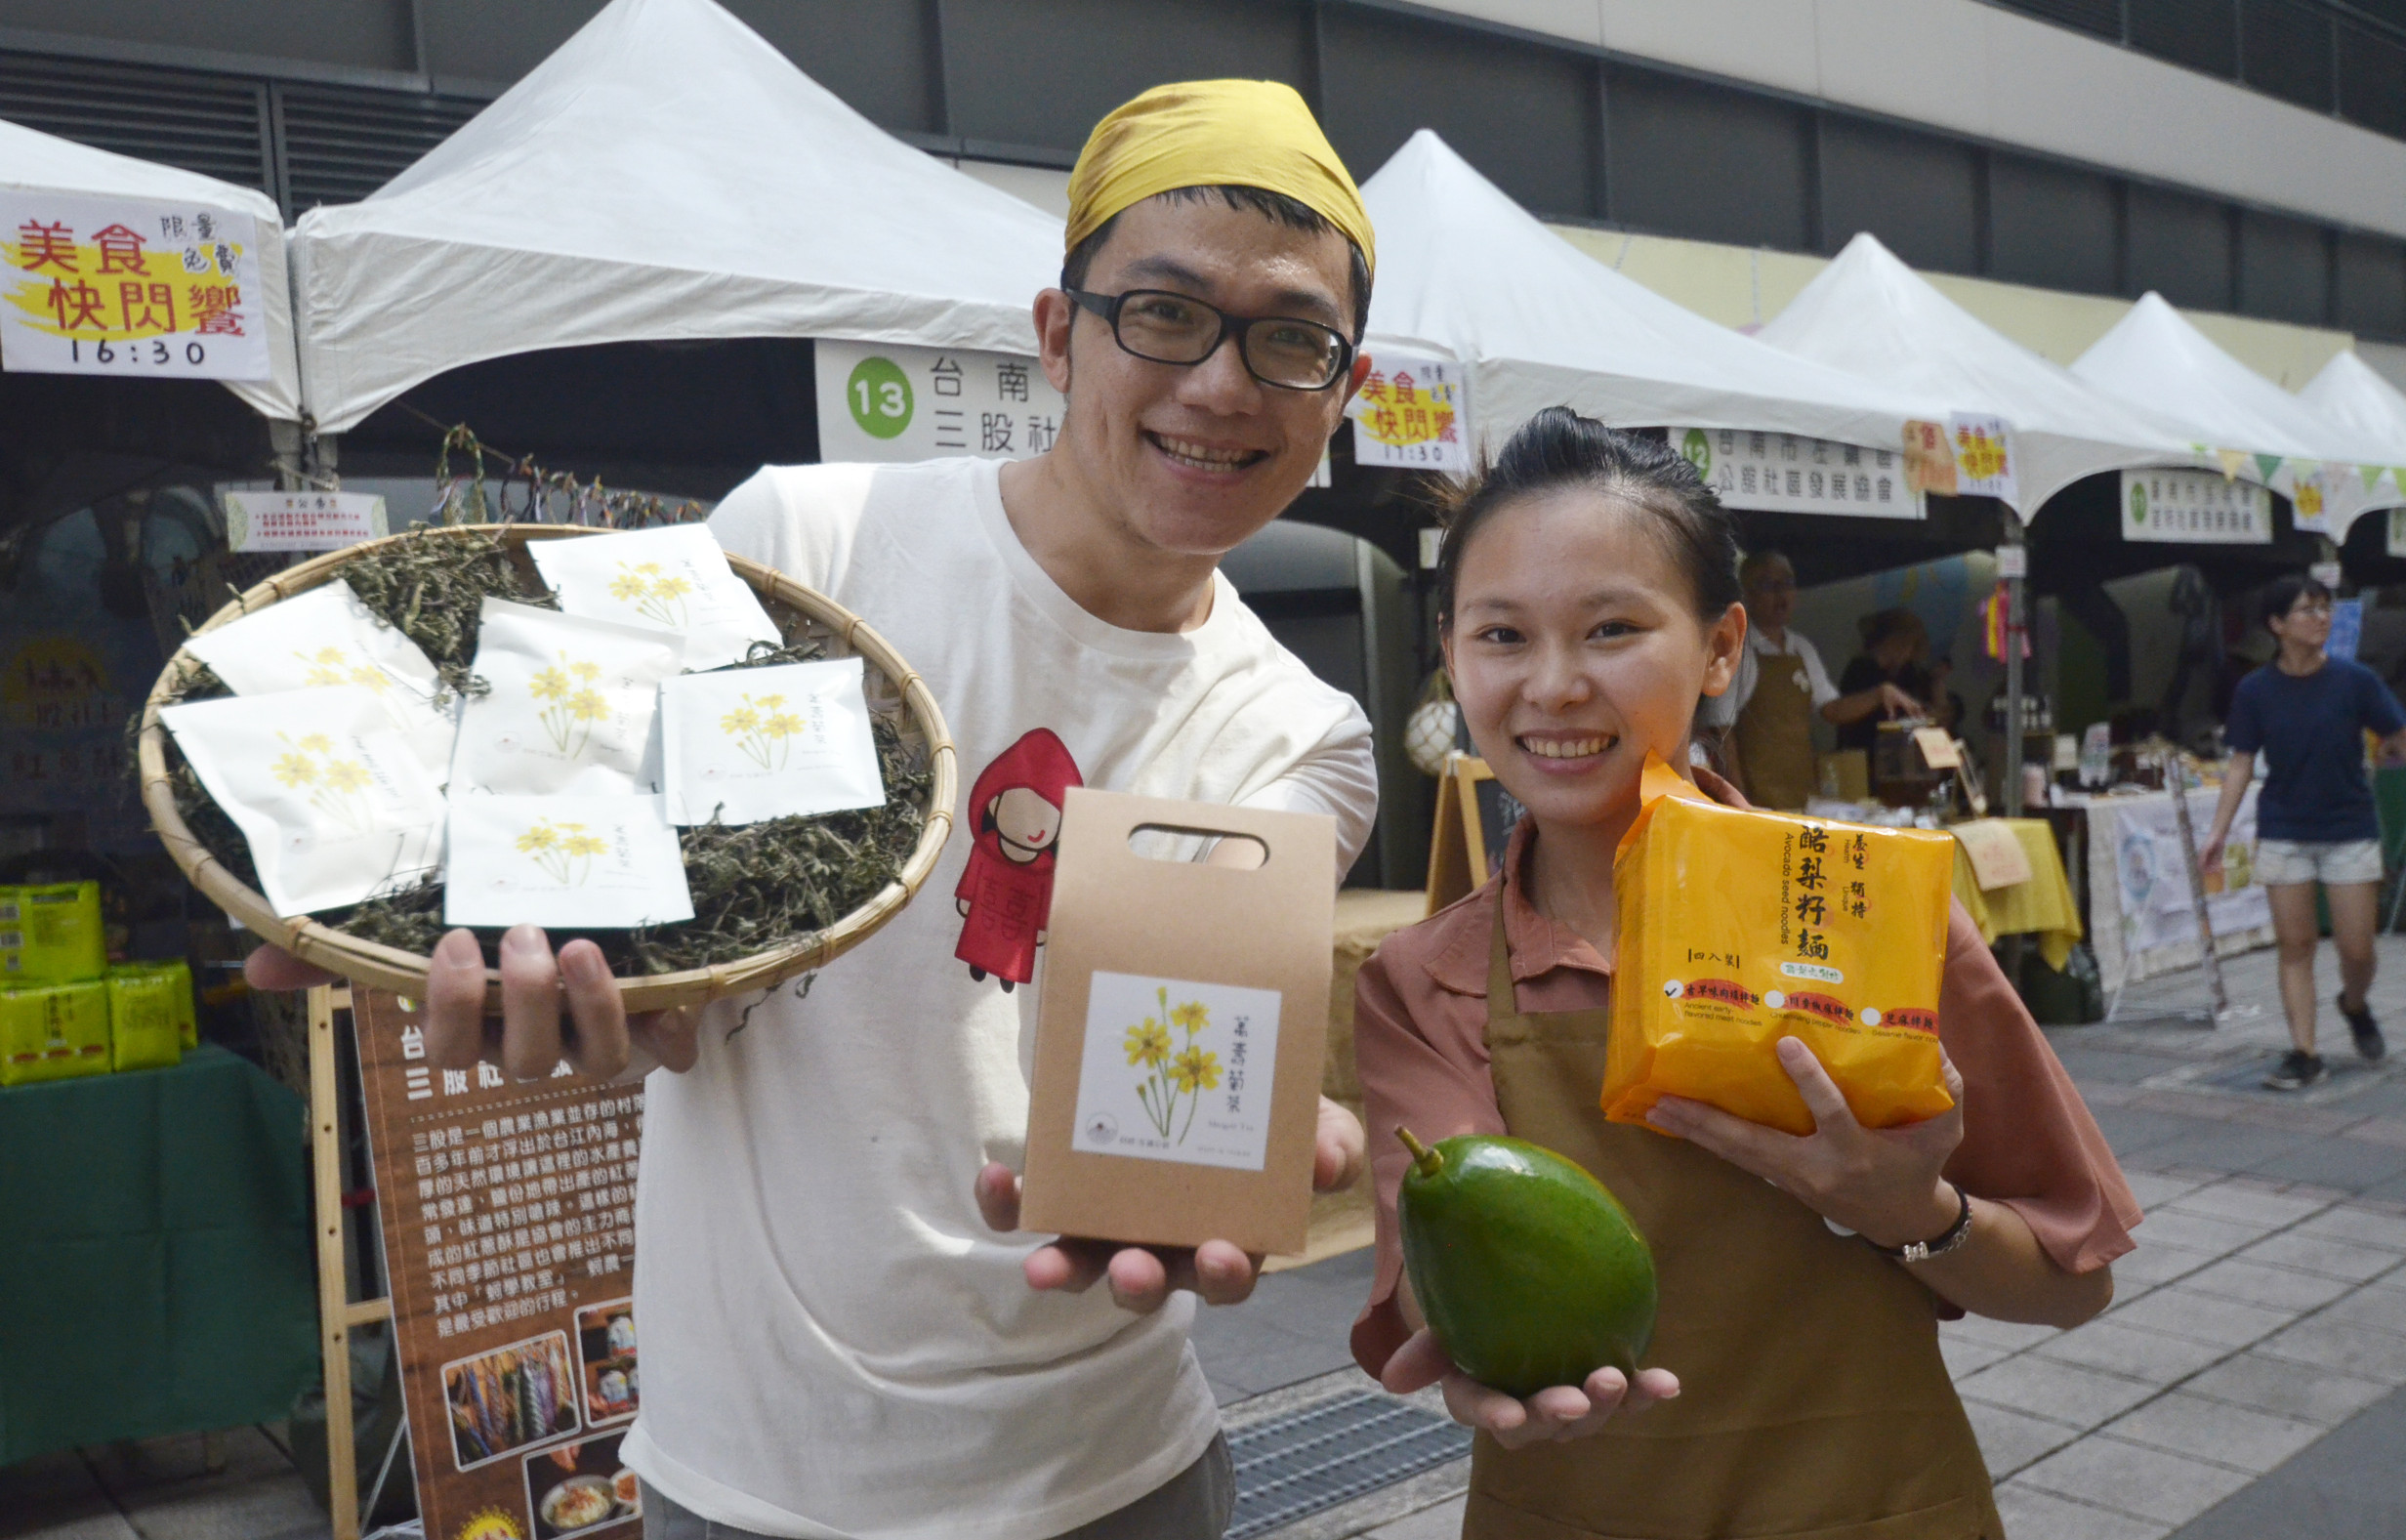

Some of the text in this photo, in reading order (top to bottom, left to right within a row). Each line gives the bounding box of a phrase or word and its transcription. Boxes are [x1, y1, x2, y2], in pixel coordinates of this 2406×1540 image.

[19, 219, 150, 276] 美食
[48, 279, 245, 337] 快閃饗
[71, 338, 205, 364] 16:30
[854, 379, 906, 417] 13
[931, 356, 1028, 402] 台南
[1364, 370, 1416, 405] 美食
[1852, 833, 1868, 870] 養生
[1780, 832, 1795, 945] Avocado seed noodles
[1796, 825, 1829, 961] 酪梨籽麵
[1716, 1014, 1734, 1022] meat
[400, 1025, 425, 1060] 台
